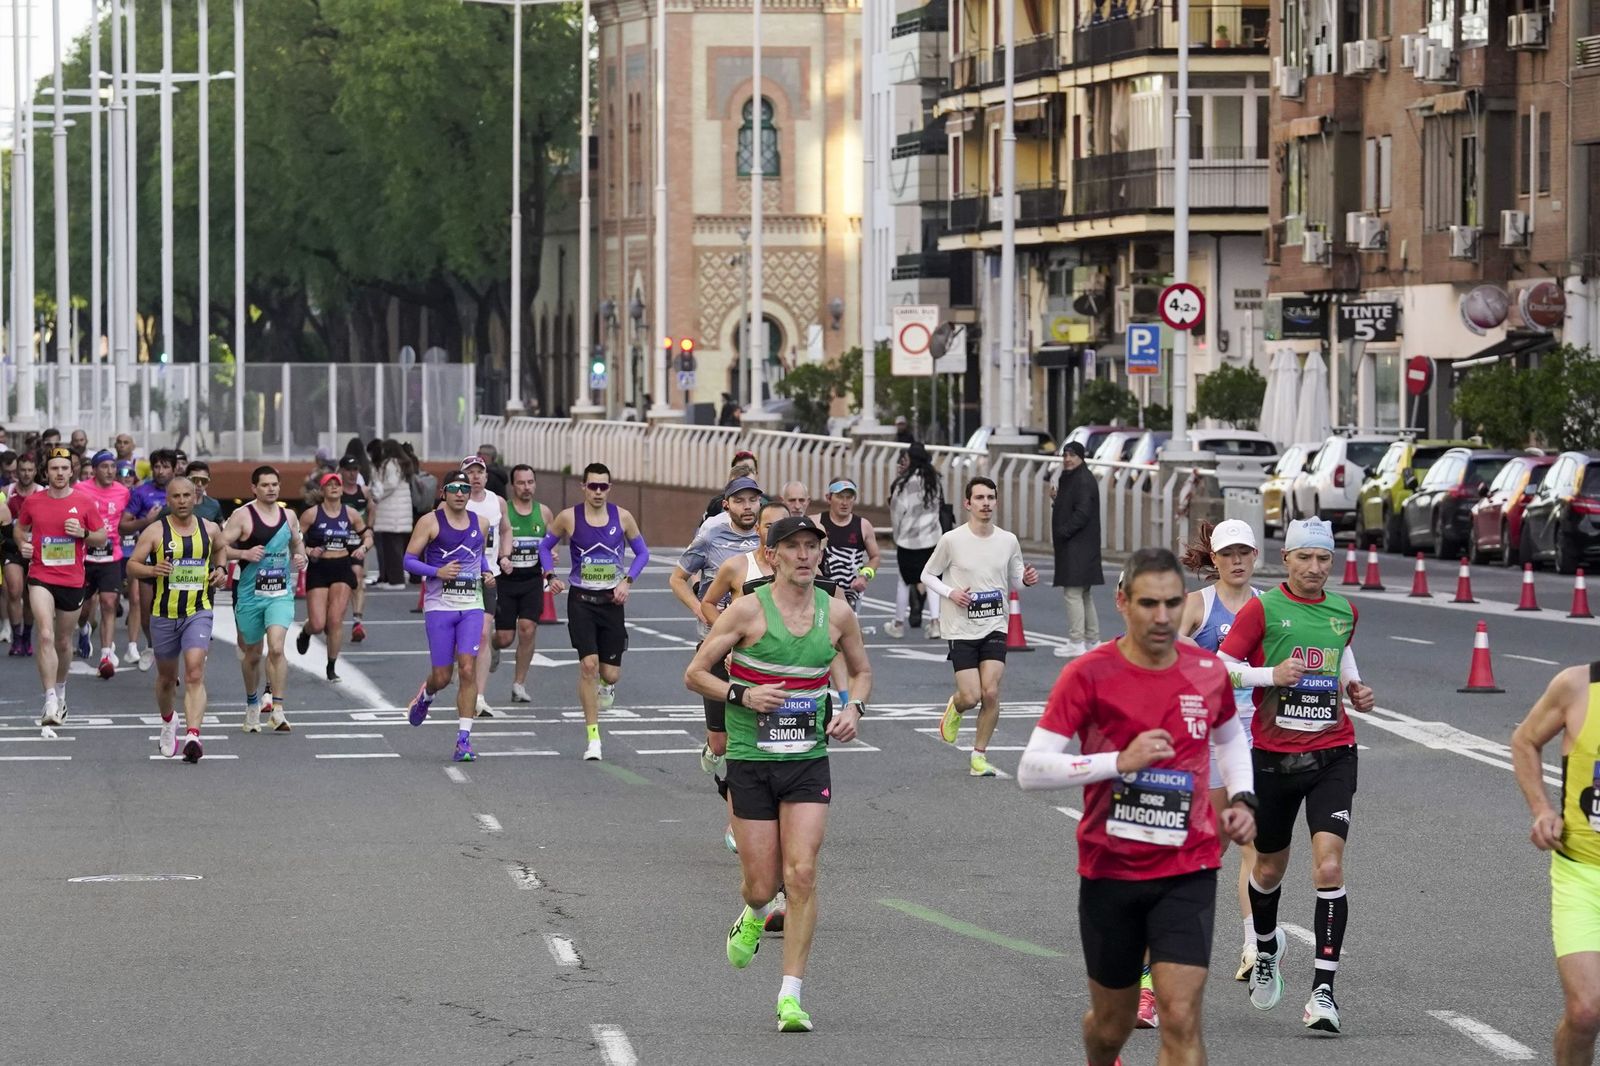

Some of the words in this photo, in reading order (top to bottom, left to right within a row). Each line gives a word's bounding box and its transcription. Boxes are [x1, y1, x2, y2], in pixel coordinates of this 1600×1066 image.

[1341, 305, 1393, 319] TINTE
[1131, 328, 1152, 356] P
[261, 583, 282, 591] OLIVER
[968, 608, 996, 618] MAXIME
[1290, 646, 1340, 672] ADN
[1302, 678, 1333, 687] ZURICH
[1301, 695, 1319, 704] 5264
[1284, 703, 1332, 719] MARCOS
[779, 717, 797, 726] 5222
[769, 728, 806, 740] SIMON
[1141, 772, 1186, 786] ZURICH
